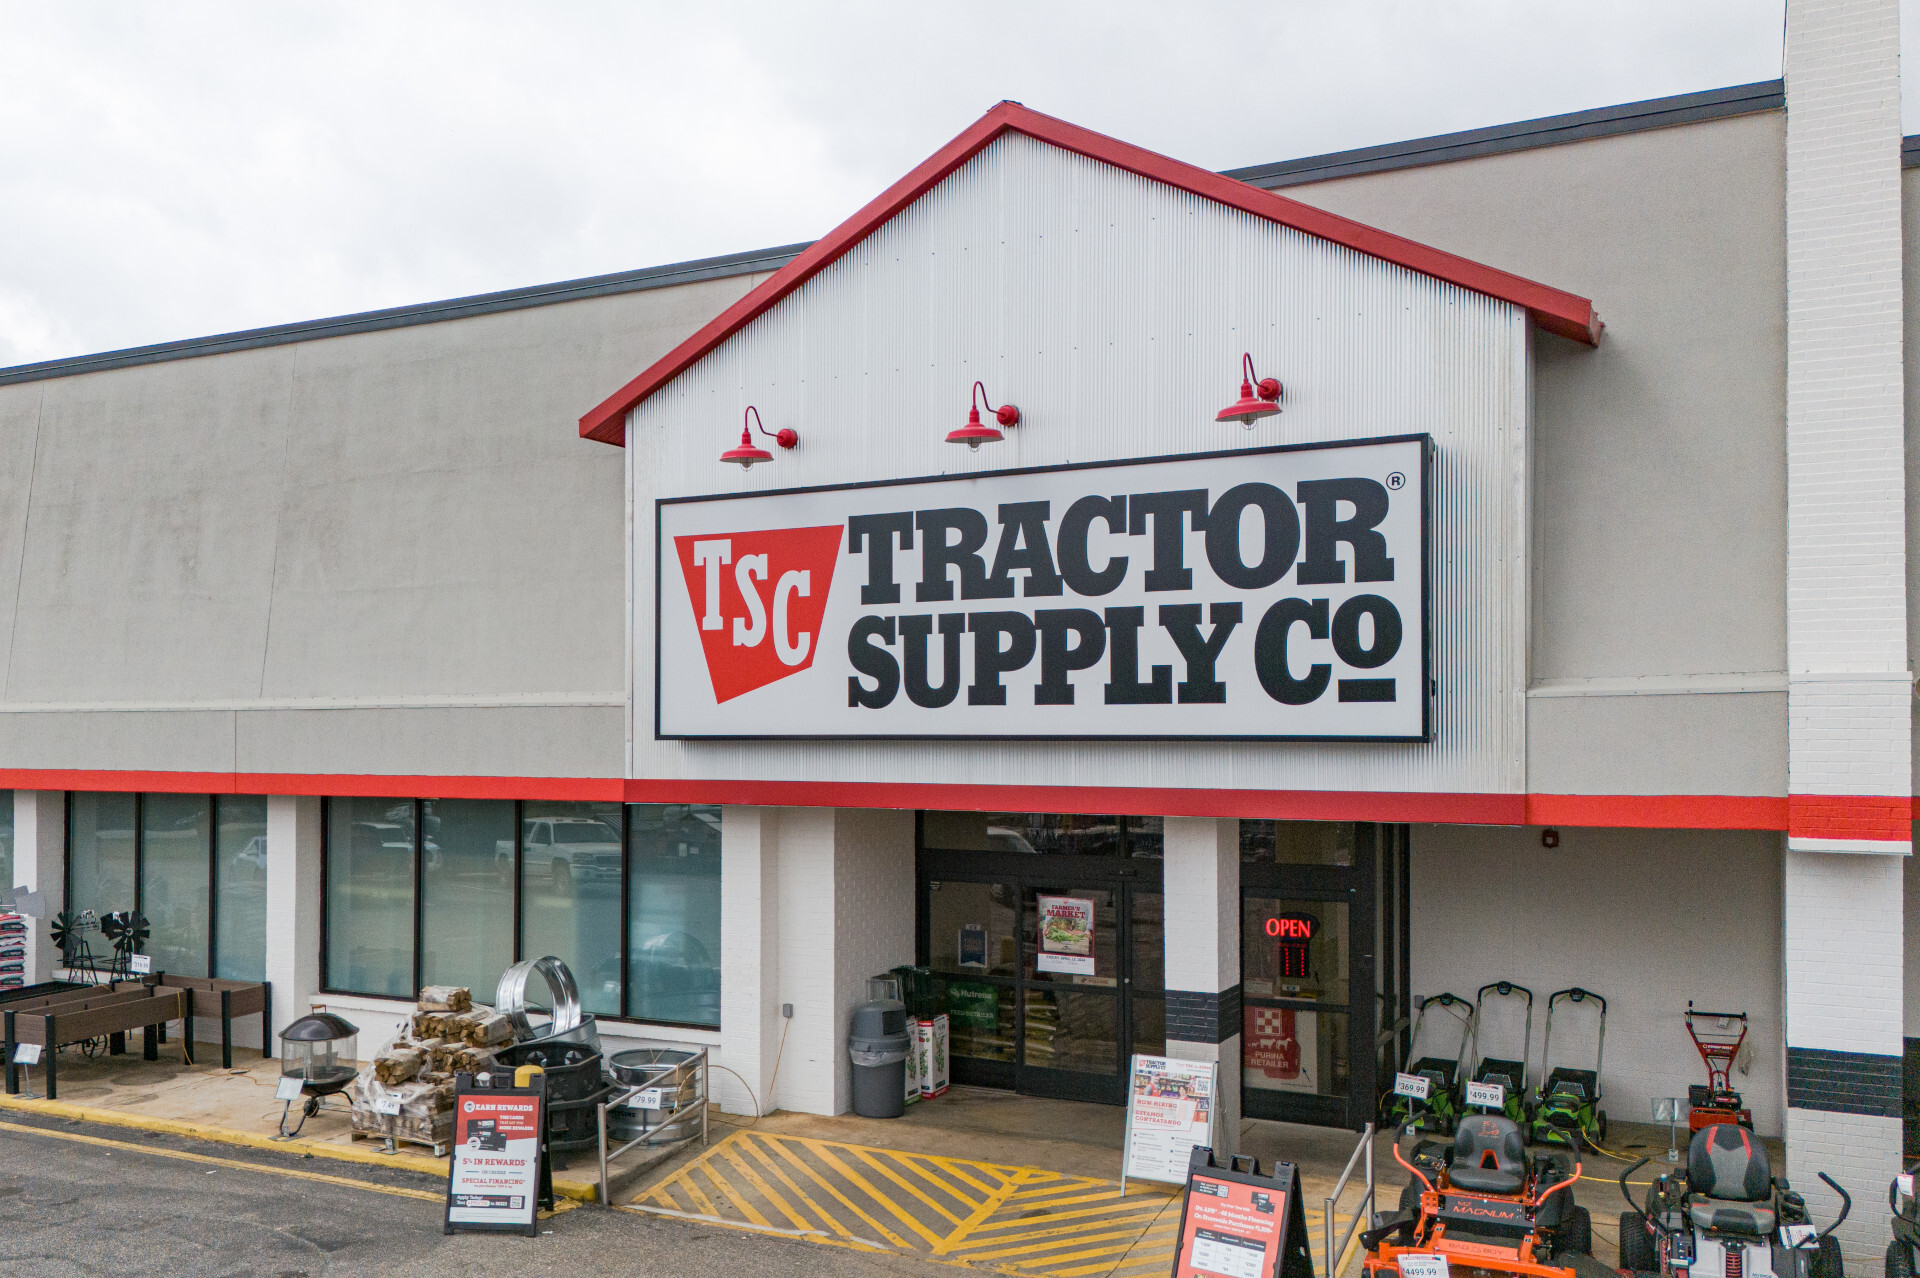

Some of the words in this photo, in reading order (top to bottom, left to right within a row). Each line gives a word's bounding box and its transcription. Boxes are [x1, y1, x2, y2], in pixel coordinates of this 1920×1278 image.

[848, 477, 1394, 605] TRACTOR
[694, 539, 810, 666] TSC
[848, 602, 1243, 709] SUPPLY
[1047, 909, 1085, 918] MARKET
[1266, 918, 1311, 938] OPEN
[961, 989, 992, 999] Nutrena
[1255, 1051, 1285, 1061] PURINA
[1251, 1058, 1289, 1069] RETAILER
[1398, 1082, 1425, 1093] $369.99
[635, 1095, 656, 1104] $79.99
[1470, 1090, 1500, 1101] $499.99
[1153, 1100, 1177, 1108] HIRING
[1135, 1110, 1164, 1118] ESTAMOS
[1135, 1116, 1182, 1126] CONTRATANDO
[1453, 1206, 1514, 1219] MAGNUM
[1448, 1242, 1469, 1250] BAD
[1483, 1247, 1504, 1255] BOY
[1402, 1267, 1437, 1276] $4499.99
